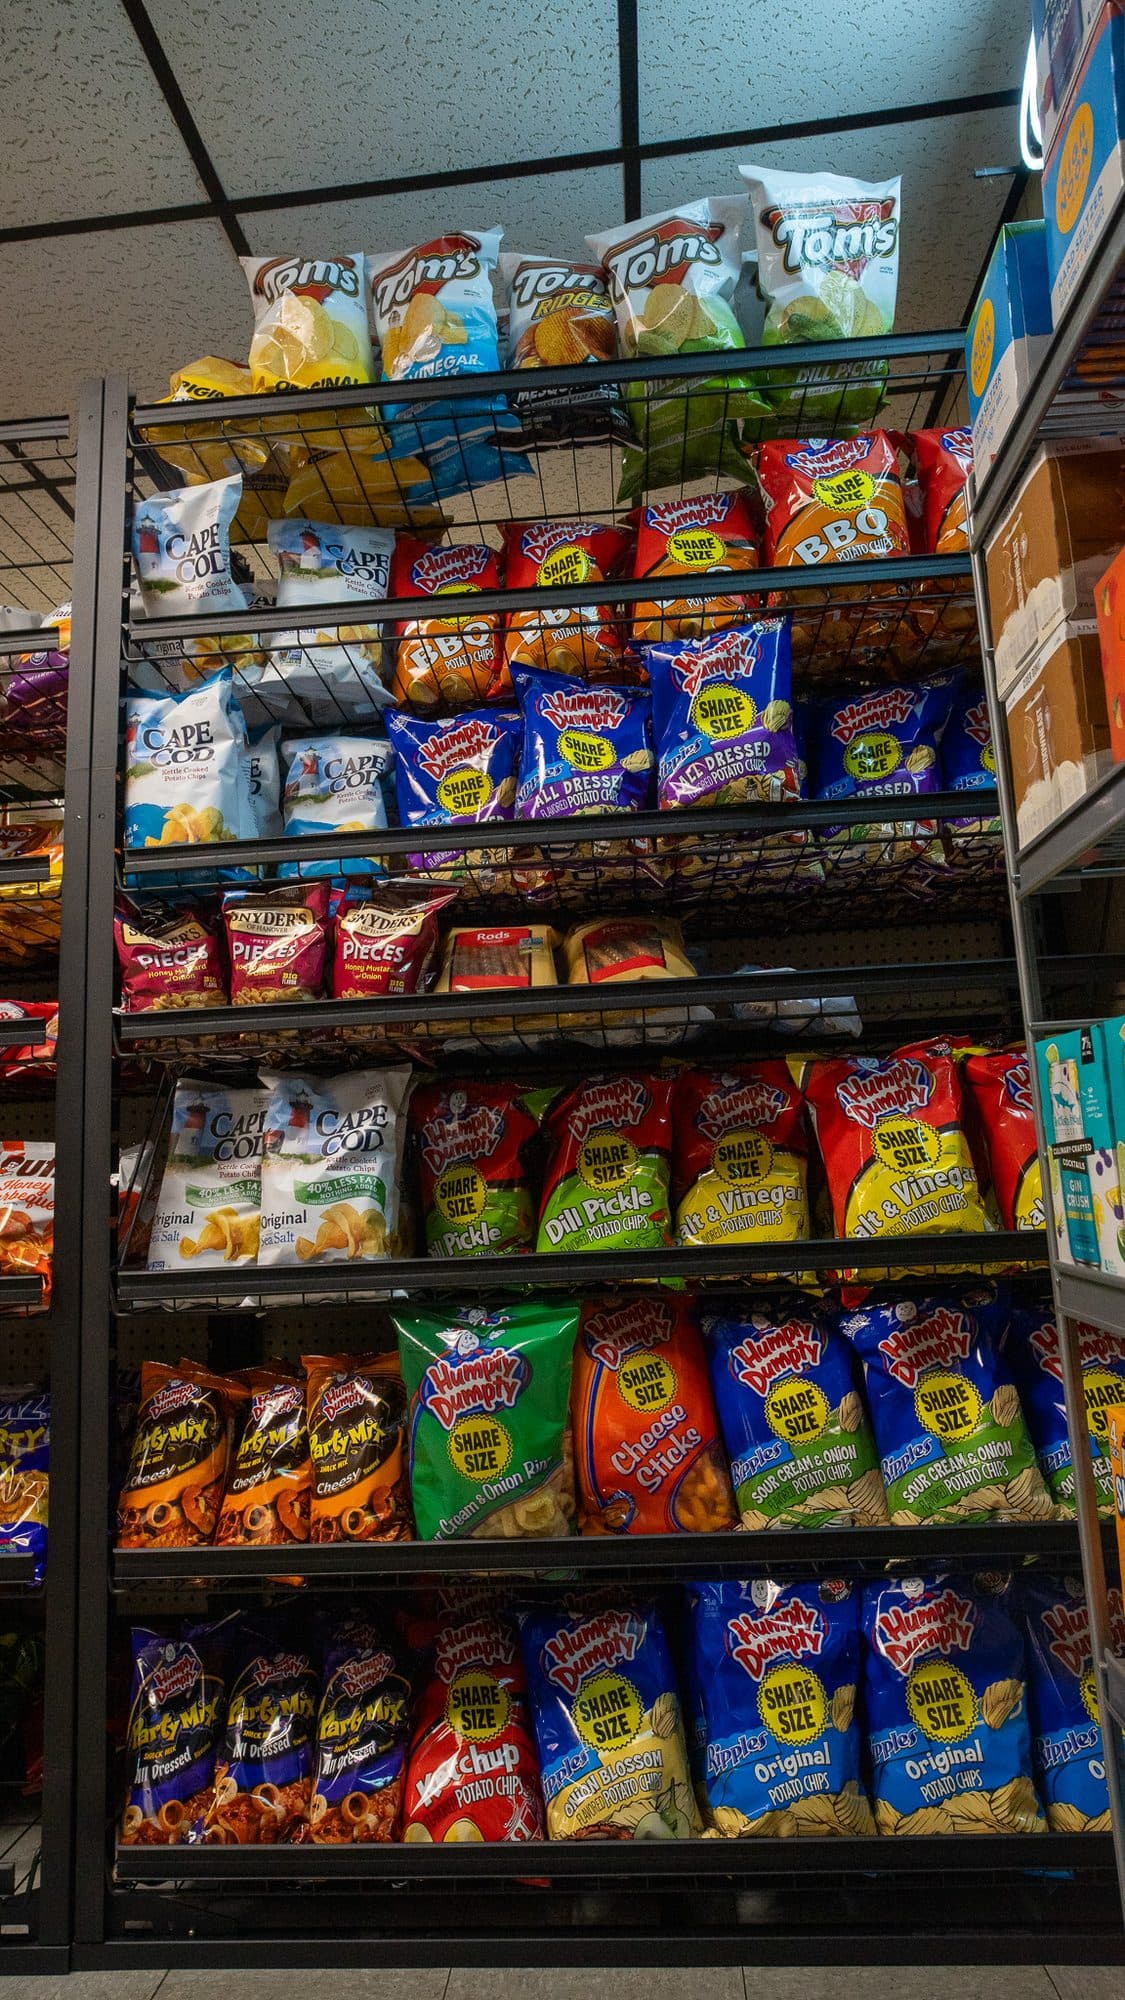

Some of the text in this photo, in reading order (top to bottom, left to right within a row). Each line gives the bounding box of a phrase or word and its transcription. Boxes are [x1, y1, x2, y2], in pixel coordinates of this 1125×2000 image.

[775, 217, 898, 272] Tom's
[264, 257, 359, 302] Tom's
[377, 252, 477, 311] Tom's
[609, 237, 720, 299] Tom's
[534, 293, 612, 318] RIDGES
[650, 506, 728, 535] Dumpty
[166, 524, 220, 560] CAPE
[794, 508, 888, 564] BBQ
[176, 551, 225, 583] COD
[326, 544, 389, 569] CAPE
[414, 546, 485, 576] Humpty
[205, 578, 231, 589] Cooked
[336, 559, 388, 587] COD
[344, 576, 364, 586] Kettle
[415, 559, 487, 594] Dumpty
[409, 621, 490, 671] BBQ
[546, 692, 625, 712] Humpty
[700, 698, 743, 719] SHARE
[836, 689, 915, 726] Humpty
[544, 709, 624, 730] Dumpty
[710, 714, 743, 734] SIZE
[832, 705, 909, 742] Dumpty
[144, 721, 213, 749] CAPE
[422, 723, 491, 760] Humpty
[566, 737, 604, 756] SHARE
[151, 747, 214, 767] COD
[162, 766, 209, 775] Kettle Cooked
[325, 755, 386, 779] CAPE
[705, 742, 771, 772] DRESSED
[330, 770, 381, 793] COD
[443, 775, 484, 797] SHARE
[453, 791, 481, 808] SIZE
[535, 787, 560, 808] ALL
[231, 911, 307, 927] SNYDER'S
[477, 930, 510, 941] Rods
[137, 944, 208, 970] PIECES
[232, 942, 296, 961] PIECES
[343, 941, 403, 962] PIECES
[282, 972, 298, 980] BIG
[840, 1061, 923, 1101] Humpty
[702, 1083, 778, 1120] Humpty
[848, 1082, 925, 1127] Dumpty
[316, 1105, 388, 1136] CAPE
[321, 1129, 384, 1157] COD
[584, 1144, 629, 1167] SHARE
[718, 1141, 762, 1160] SHARE
[727, 1161, 761, 1180] SIZE
[1063, 1159, 1085, 1170] COCKTAILS
[4, 1179, 51, 1195] Honey
[307, 1175, 379, 1193] 40% LESS FAT
[320, 1185, 377, 1199] NOTHING ADDED
[440, 1175, 478, 1197] SHARE
[1070, 1180, 1082, 1192] GIN
[0, 1188, 55, 1210] rbeque
[447, 1199, 476, 1218] SIZE
[901, 1193, 969, 1227] POTATO CHIPS
[1067, 1194, 1089, 1208] CRUSH
[261, 1209, 307, 1230] Original
[545, 1187, 652, 1244] Dill Pickle
[587, 1214, 648, 1242] POTATO CHIPS
[721, 1209, 782, 1238] POTATO CHIPS
[275, 1231, 295, 1243] Salt
[443, 1222, 501, 1252] Pickle
[733, 1319, 814, 1367] Humpty
[880, 1308, 963, 1356] Humpty
[427, 1348, 520, 1395] Humpty
[621, 1361, 666, 1387] SHARE
[740, 1340, 821, 1396] Dumpty
[889, 1332, 971, 1388] Dumpty
[428, 1378, 519, 1431] Dumpty
[635, 1382, 667, 1406] SIZE
[770, 1390, 818, 1420] SHARE
[920, 1384, 970, 1412] SHARE
[784, 1411, 820, 1439] SIZE
[935, 1406, 972, 1432] SIZE
[311, 1418, 385, 1461] Party Mix
[454, 1428, 501, 1454] SHARE
[611, 1404, 687, 1475] Cheese
[464, 1451, 498, 1474] SIZE
[636, 1428, 702, 1495] Sticks
[732, 1441, 782, 1483] Ripples
[751, 1477, 778, 1504] SOUR
[778, 1457, 813, 1483] CREAM
[824, 1444, 857, 1463] ONION
[881, 1437, 932, 1482] Ripples
[902, 1477, 930, 1504] SOUR
[930, 1453, 966, 1482] CREAM
[978, 1440, 1013, 1460] ONION
[131, 1465, 175, 1488] Cheesy
[233, 1467, 270, 1490] Cheesy
[317, 1468, 360, 1494] Cheesy
[793, 1462, 853, 1493] POTATO CHIPS
[944, 1459, 1009, 1494] POTATO CHIPS
[439, 1470, 524, 1535] Cream Onion
[547, 1610, 631, 1662] Humpty
[551, 1633, 636, 1694] Dumpty
[733, 1625, 822, 1681] Dumpty
[228, 1690, 316, 1726] Party Mix
[452, 1687, 500, 1707] SHARE
[579, 1686, 631, 1722] SHARE
[764, 1680, 815, 1709] SHARE
[132, 1697, 219, 1748] Party Mix
[320, 1696, 404, 1740] Party Mix
[461, 1710, 497, 1730] SIZE
[592, 1714, 630, 1743] SIZE
[778, 1705, 814, 1734] SIZE
[927, 1702, 965, 1732] SIZE
[151, 1748, 192, 1778] Dressed
[707, 1732, 767, 1775] Ripples
[754, 1742, 831, 1782] Original
[904, 1742, 984, 1781] Original
[454, 1778, 522, 1808] POTATO CHIPS
[564, 1750, 663, 1817] ONION BLOSSOM
[768, 1772, 830, 1805] POTATO CHIPS
[920, 1769, 983, 1803] POTATO CHIPS
[576, 1796, 603, 1825] FLAVORED
